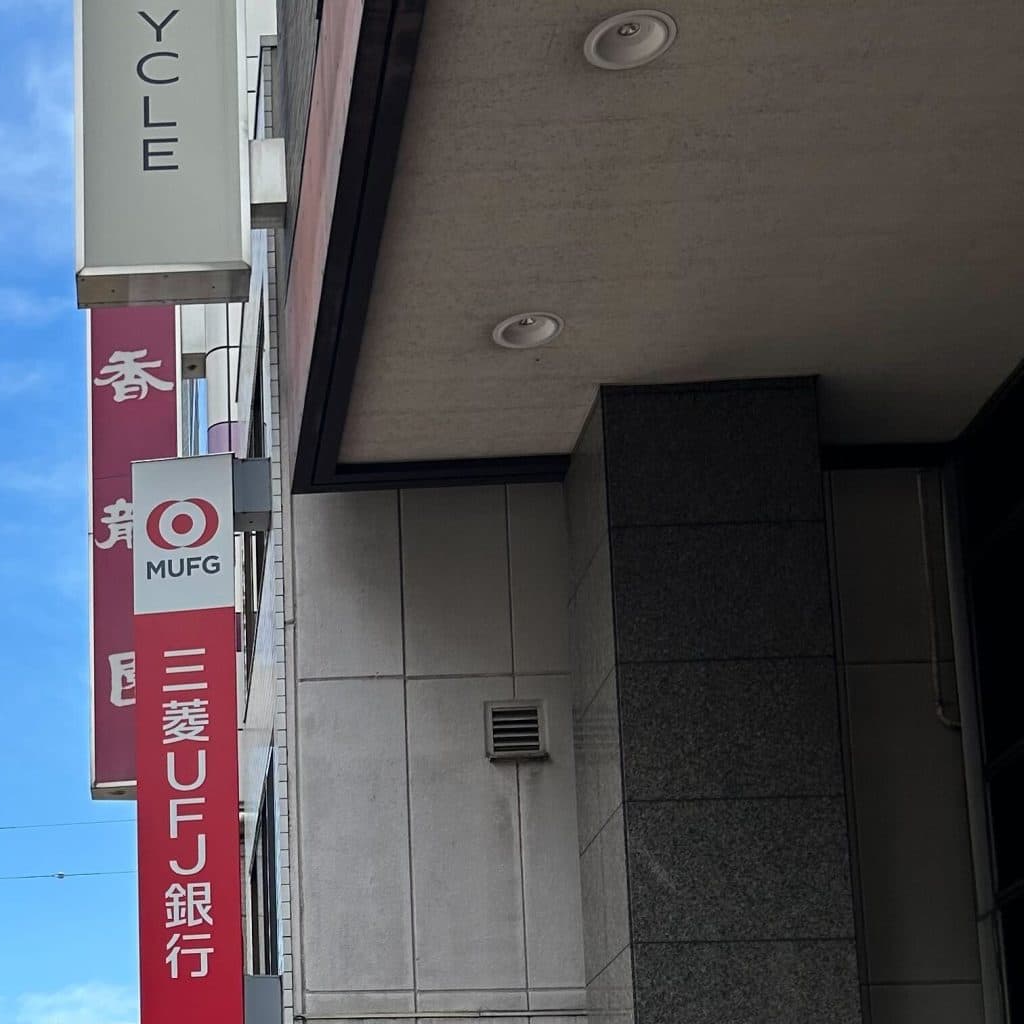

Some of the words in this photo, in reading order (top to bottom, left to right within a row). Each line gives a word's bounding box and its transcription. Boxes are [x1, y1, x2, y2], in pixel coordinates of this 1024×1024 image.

[136, 9, 180, 172] YCLE
[146, 555, 221, 580] MUFG
[162, 647, 214, 979] 三菱UFJ銀行
